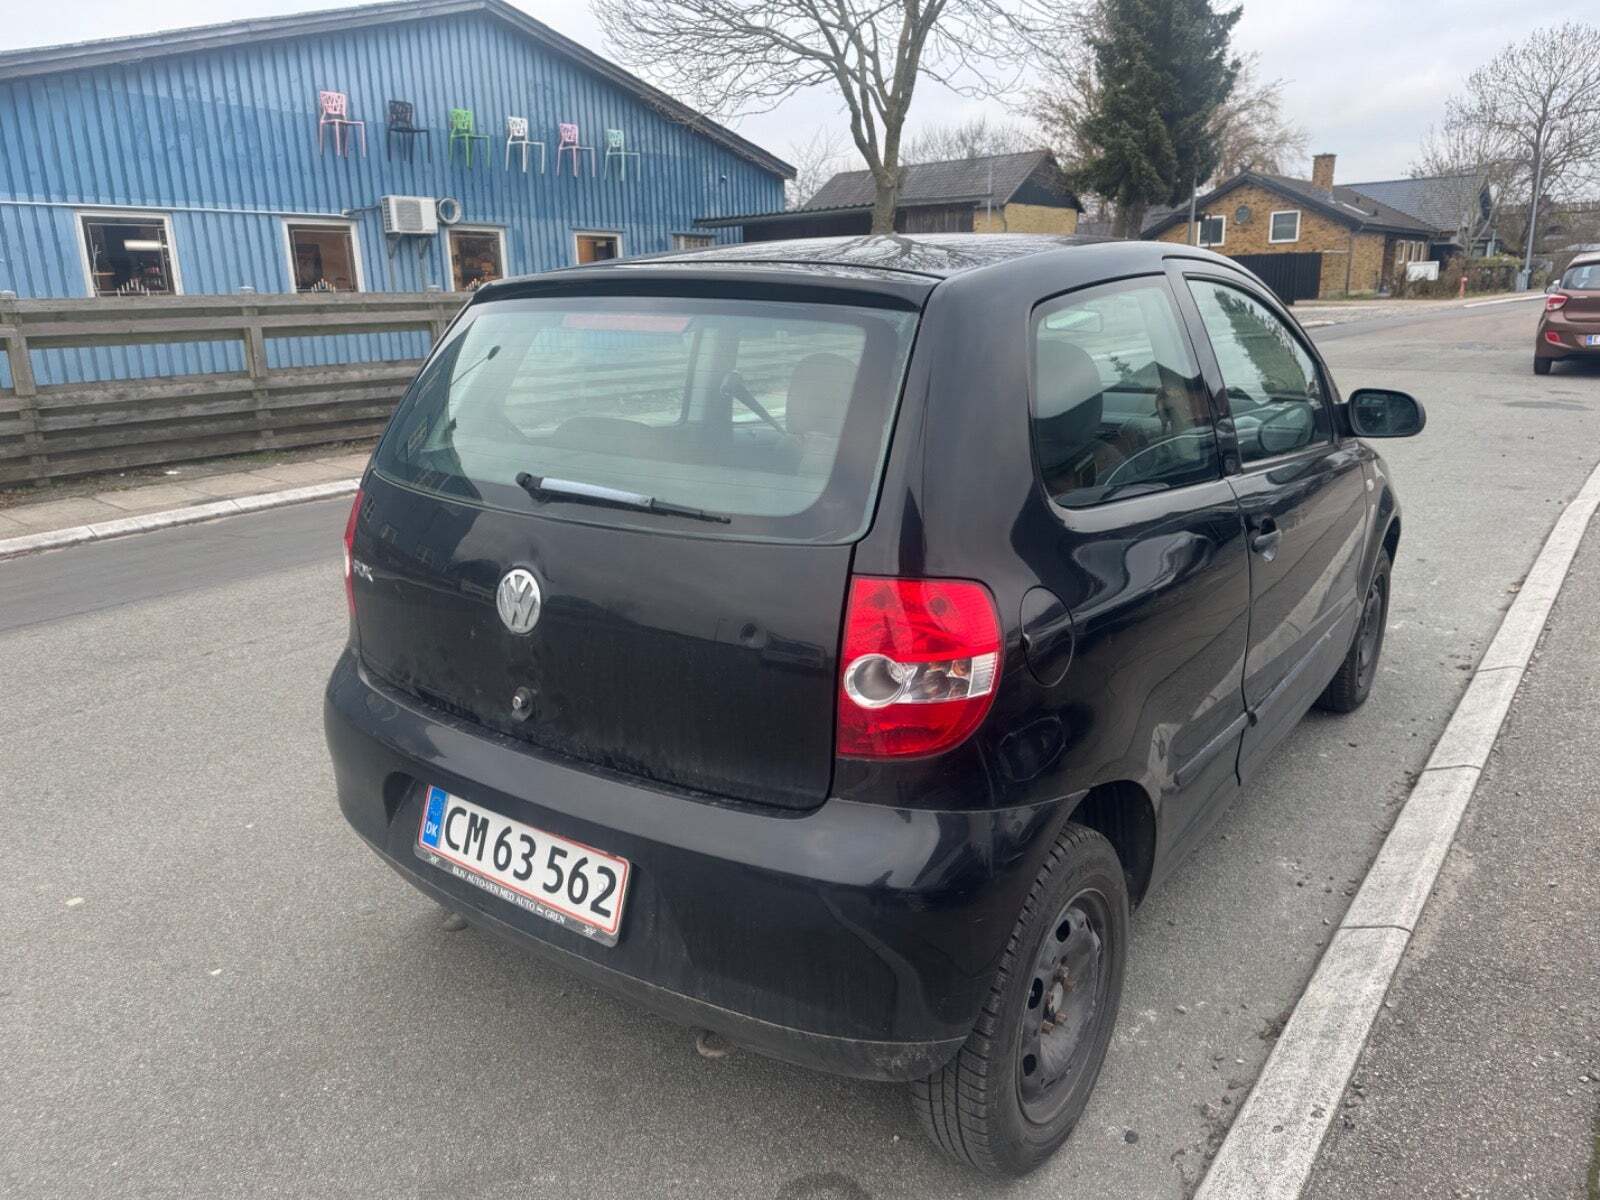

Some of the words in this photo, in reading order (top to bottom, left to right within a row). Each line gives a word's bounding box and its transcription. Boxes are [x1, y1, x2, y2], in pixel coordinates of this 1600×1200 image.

[425, 820, 438, 837] DK
[445, 806, 490, 862] CM
[493, 826, 537, 881] 63
[542, 845, 617, 919] 562
